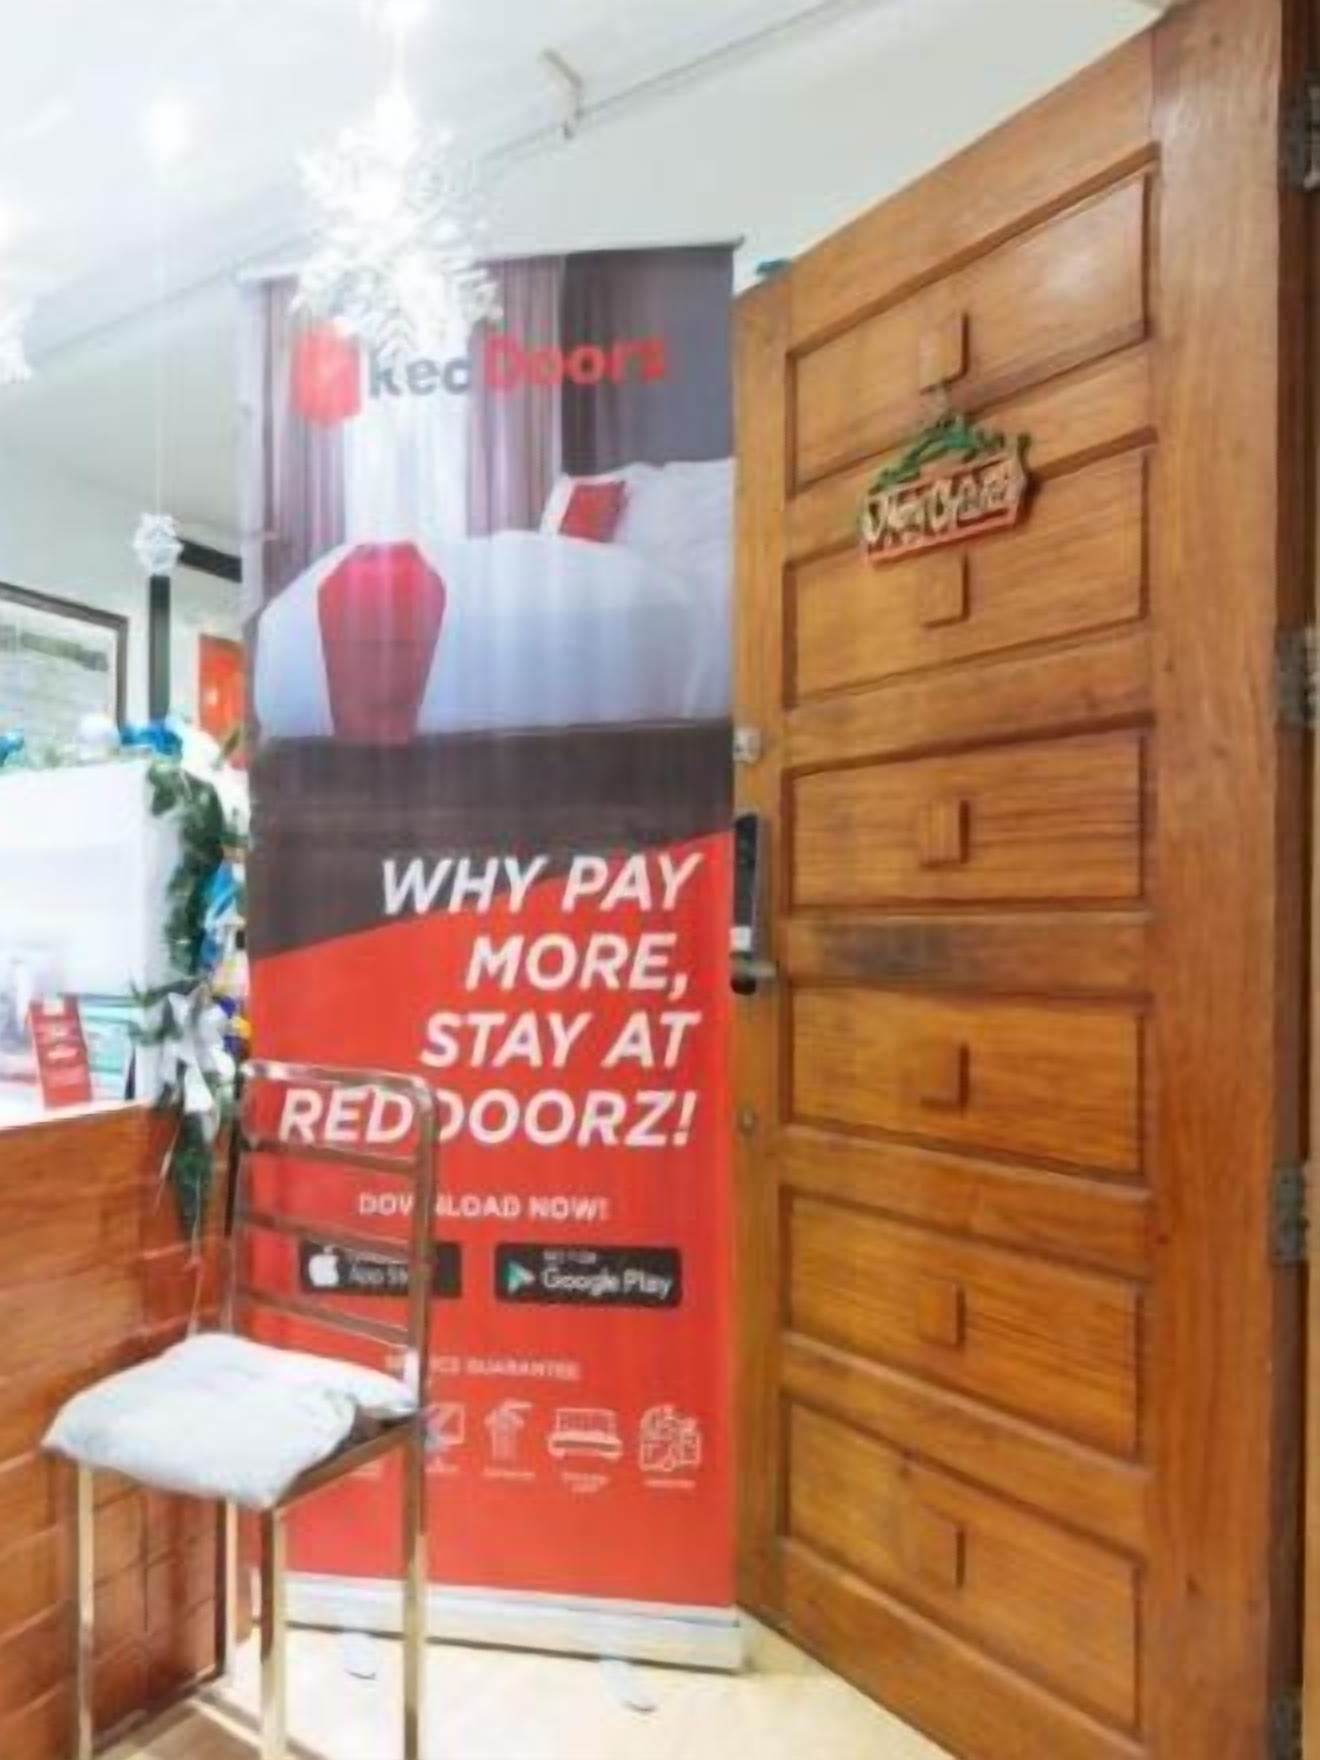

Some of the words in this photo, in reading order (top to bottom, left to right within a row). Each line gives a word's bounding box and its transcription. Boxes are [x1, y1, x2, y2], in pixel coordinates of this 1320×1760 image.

[382, 854, 548, 915] WHY
[561, 852, 705, 913] PAY
[465, 932, 689, 1000] MORE,
[418, 1011, 592, 1068] STAY
[600, 1011, 703, 1069] AT
[528, 1195, 610, 1222] NOW!
[540, 1266, 621, 1297] Google
[623, 1268, 674, 1300] Play
